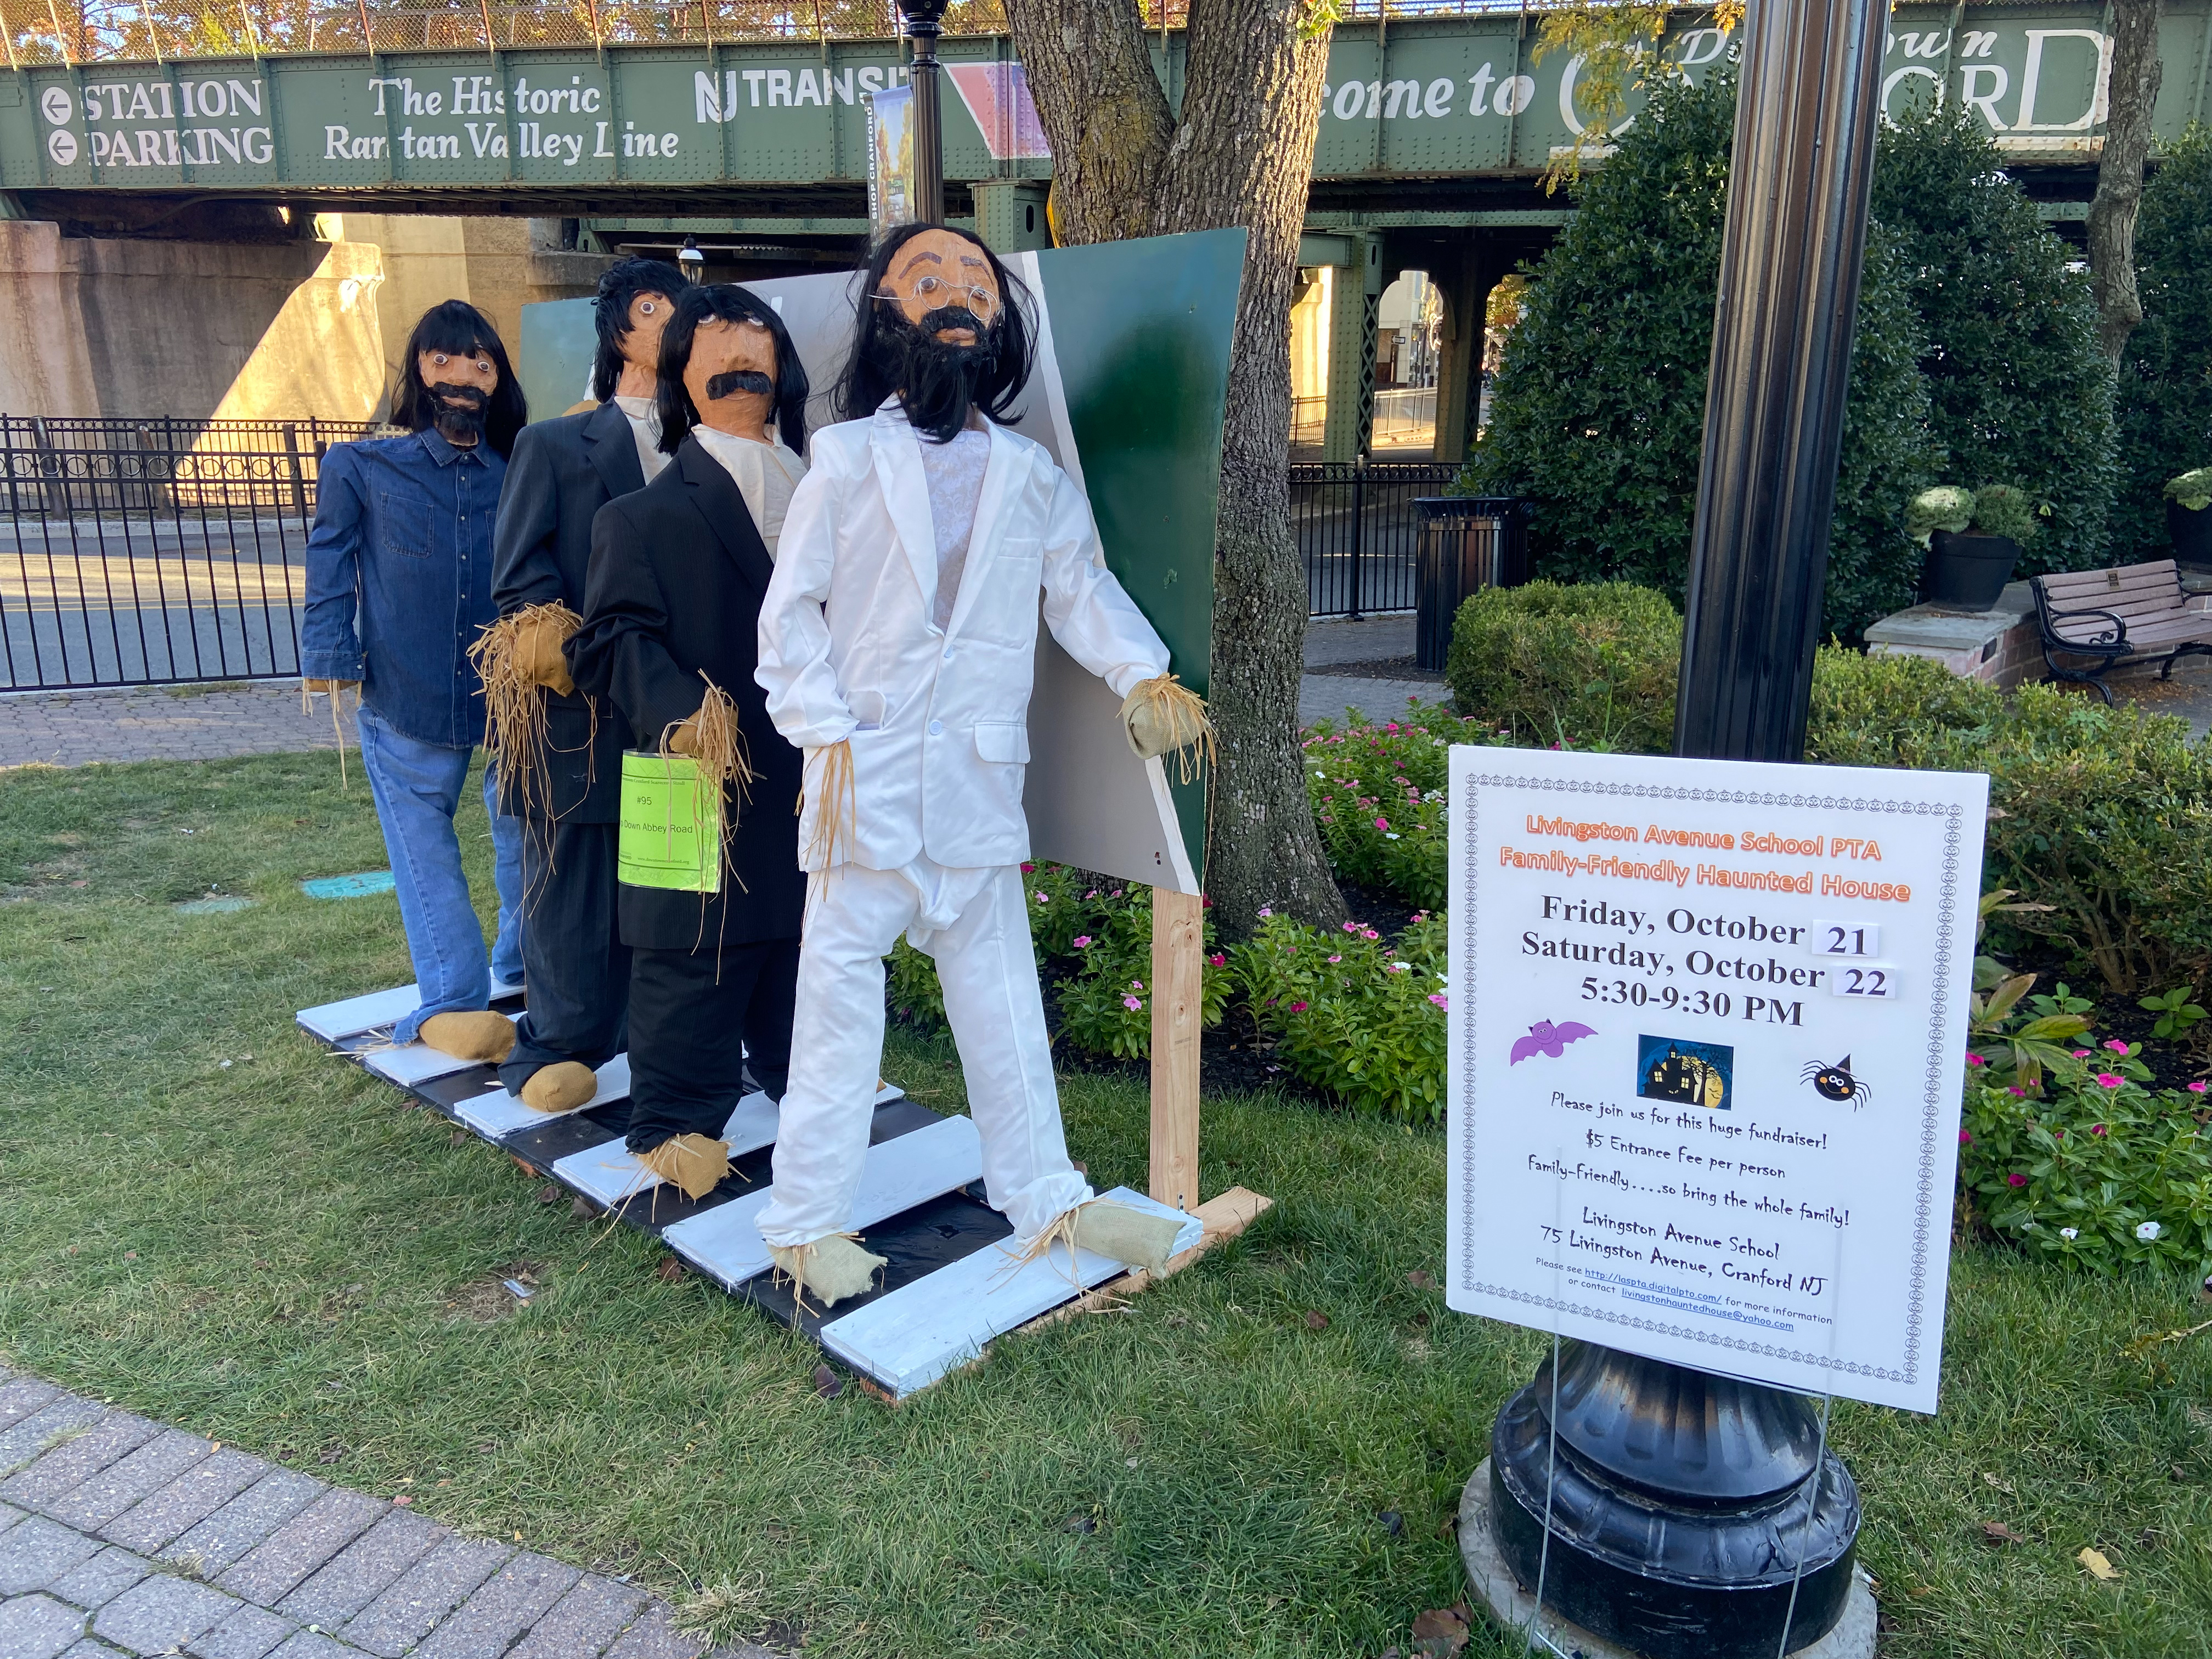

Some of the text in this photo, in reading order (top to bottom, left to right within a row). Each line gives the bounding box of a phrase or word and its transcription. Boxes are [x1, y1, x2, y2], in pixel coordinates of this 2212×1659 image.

[80, 79, 262, 121] STATION
[369, 76, 600, 116] The Historic
[695, 71, 737, 123] NJ
[1468, 61, 1536, 116] to
[84, 127, 273, 167] PARKING
[324, 121, 679, 166] Rartan Valley Line
[867, 106, 876, 180] CRANFORD
[636, 796, 652, 805] #95
[624, 819, 640, 830] Down
[642, 822, 667, 834] Abbey
[670, 824, 692, 833] Road
[1527, 815, 1881, 861] Livingston Avenue School PTA
[1500, 847, 1910, 902] Family-Friendly Haunted House
[1541, 895, 1867, 955] Friday, October 21
[1522, 932, 1886, 996] Saturday, October 22
[1582, 977, 1805, 1026] 5:30-9:30 PM
[1551, 1091, 1826, 1149] Please join us for this huge fundraiser!
[1585, 1128, 1604, 1149] $5
[1611, 1136, 1671, 1159] Entrance
[1709, 1158, 1733, 1171] per
[1740, 1163, 1785, 1178] person
[1683, 1183, 1716, 1206] bring
[1723, 1190, 1747, 1207] the
[1754, 1196, 1793, 1215] whole
[1799, 1203, 1849, 1228] family!
[1583, 1206, 1780, 1260] Livingston Avenue School
[1541, 1225, 1828, 1296] 75 Livingston Avenue, Cranford NJ
[1536, 1257, 1564, 1270] Please
[1725, 1297, 1741, 1306] for
[1745, 1302, 1769, 1312] more
[1773, 1306, 1832, 1325] information
[1581, 1282, 1616, 1293] contact
[1622, 1288, 1794, 1332] livingstonhauntedhouse@yahoo.com
